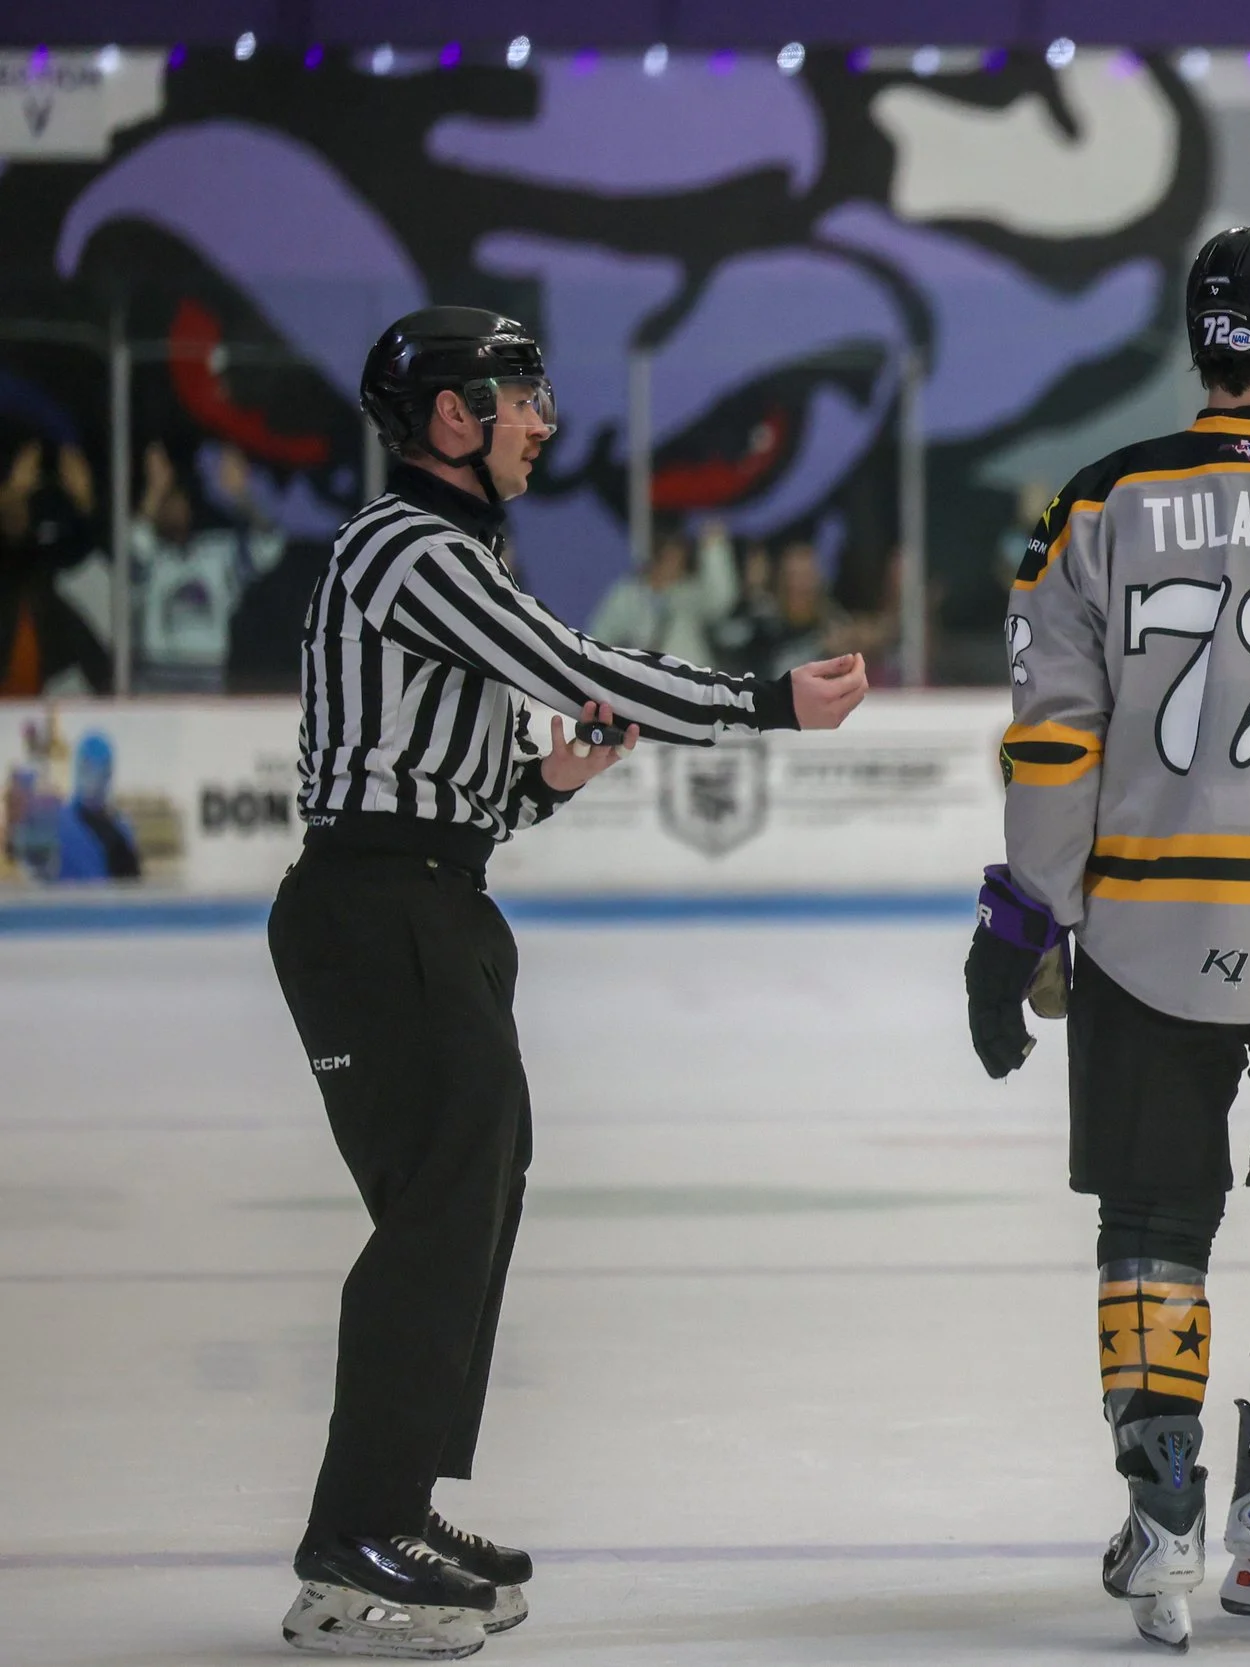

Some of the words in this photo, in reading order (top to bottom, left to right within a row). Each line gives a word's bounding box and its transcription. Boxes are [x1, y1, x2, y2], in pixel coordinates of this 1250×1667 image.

[1203, 315, 1231, 346] 72
[1231, 333, 1250, 344] NAHL
[312, 1053, 351, 1072] CCM
